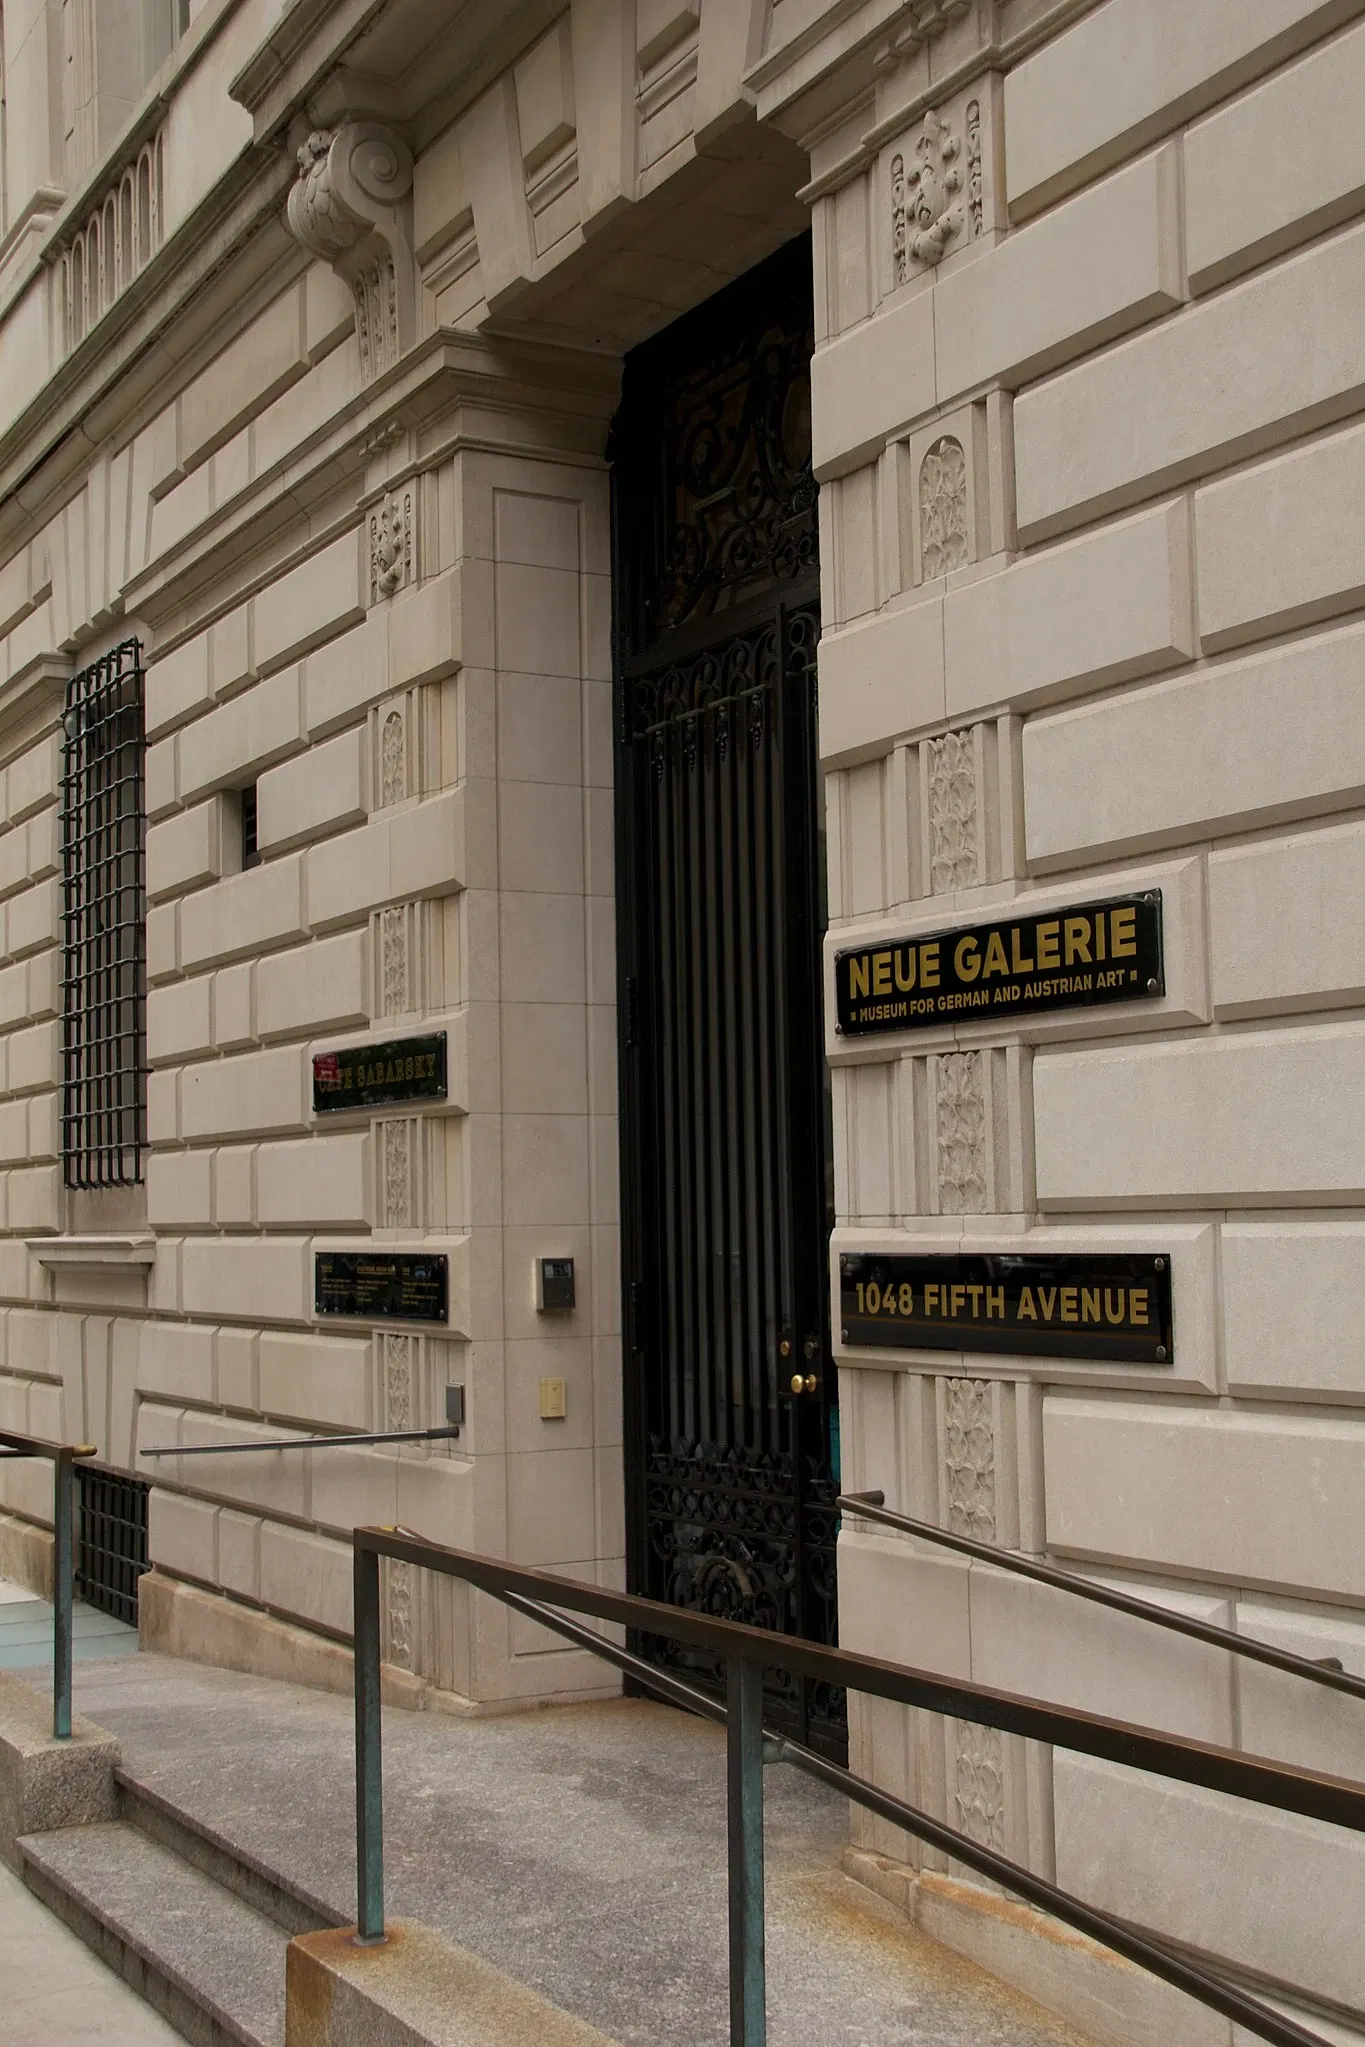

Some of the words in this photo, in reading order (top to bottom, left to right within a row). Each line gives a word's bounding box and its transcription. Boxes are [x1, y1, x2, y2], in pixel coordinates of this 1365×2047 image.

[849, 943, 941, 1000] NEUE
[954, 907, 1137, 983] GALERIE
[859, 1002, 907, 1022] MUSEUM
[910, 999, 935, 1015] FOR
[937, 989, 989, 1011] GERMAN
[993, 987, 1021, 1003] AND
[1024, 977, 1093, 1000] AUSTRIAN
[1096, 969, 1126, 989] ART
[357, 1053, 437, 1088] SABARSKY
[856, 1282, 914, 1316] 1048
[924, 1284, 1006, 1319] FIFTH
[1017, 1286, 1150, 1325] AVENUE
